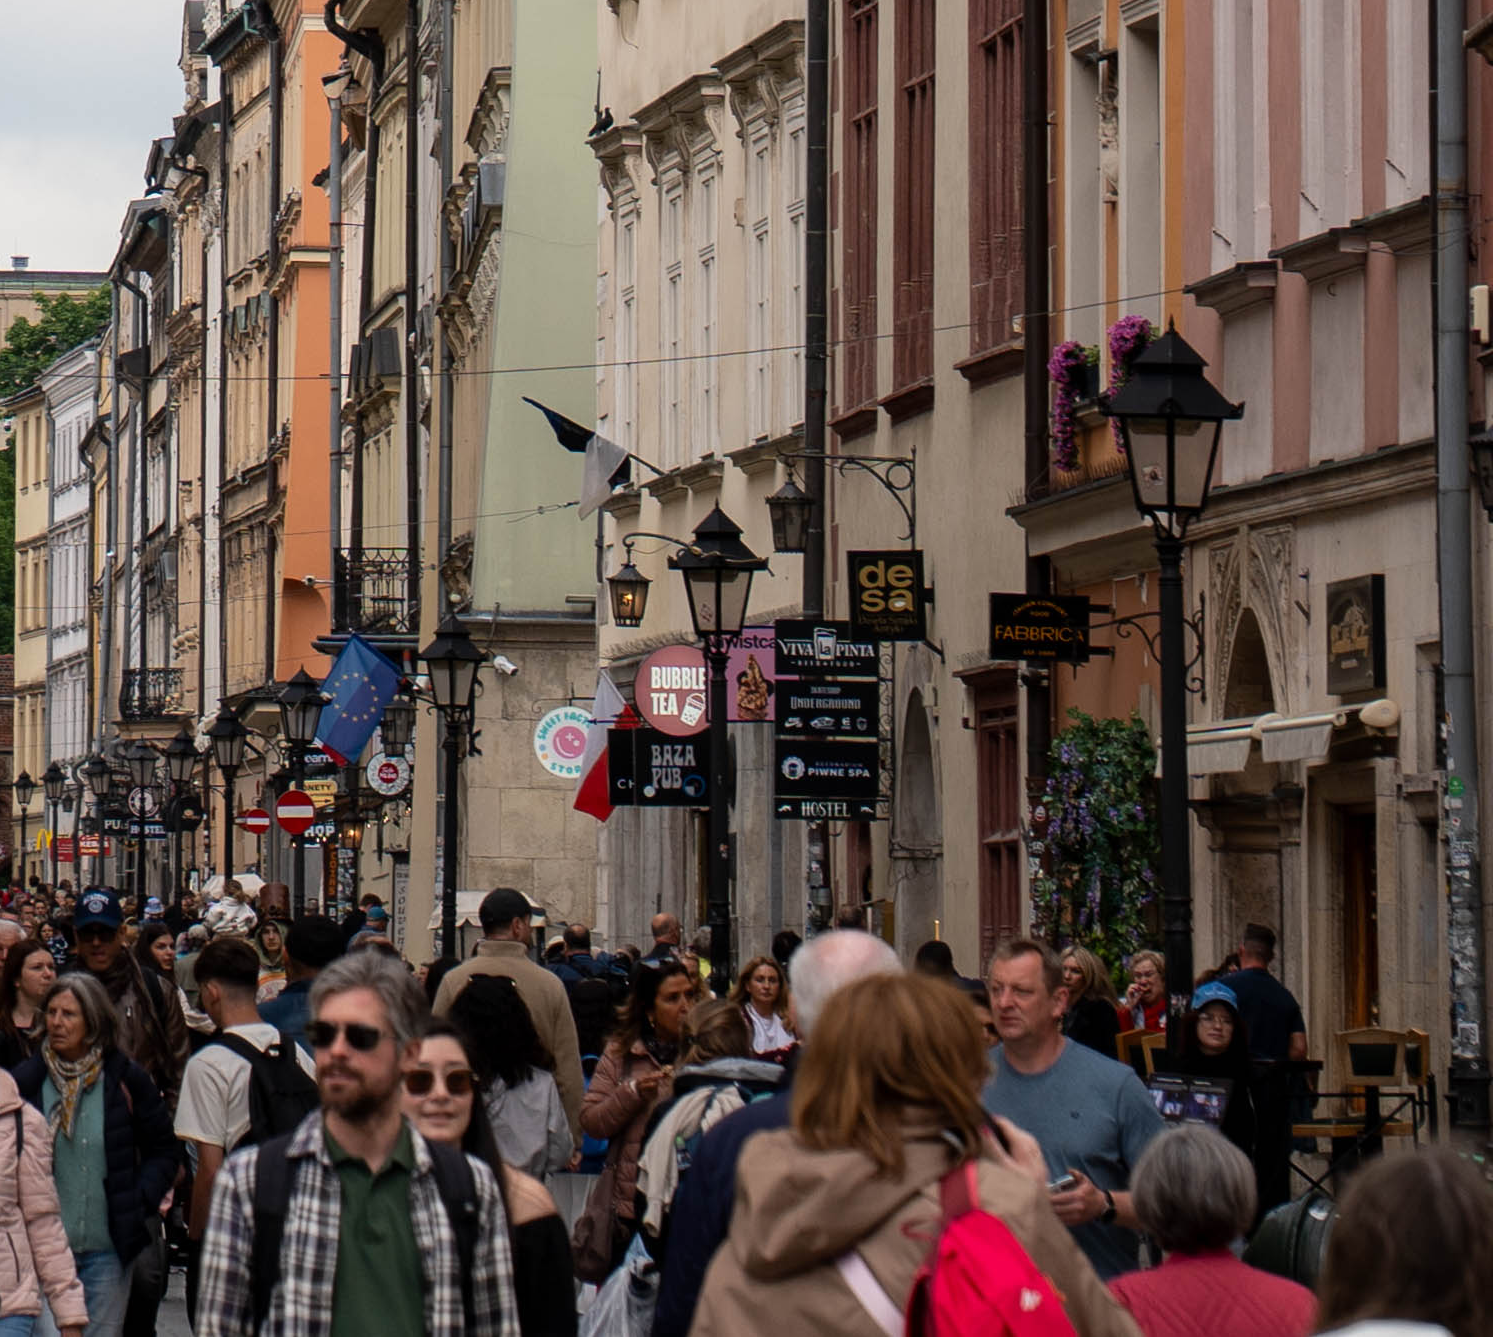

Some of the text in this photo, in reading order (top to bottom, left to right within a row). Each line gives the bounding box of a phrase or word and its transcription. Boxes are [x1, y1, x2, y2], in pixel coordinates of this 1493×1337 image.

[779, 640, 814, 658] VIVA
[836, 643, 875, 659] PINTA
[650, 666, 706, 690] BUBBLE
[650, 692, 679, 716] TEA
[790, 695, 861, 710] UNDERGROUND
[538, 711, 590, 741] SWEET FACT
[650, 744, 697, 768] BAZA
[550, 762, 581, 775] STOR
[808, 767, 871, 778] PIWNE SPA
[650, 768, 683, 790] PUB
[801, 801, 851, 818] HOSTEL
[130, 824, 166, 835] HSTEL
[304, 825, 335, 838] HOP
